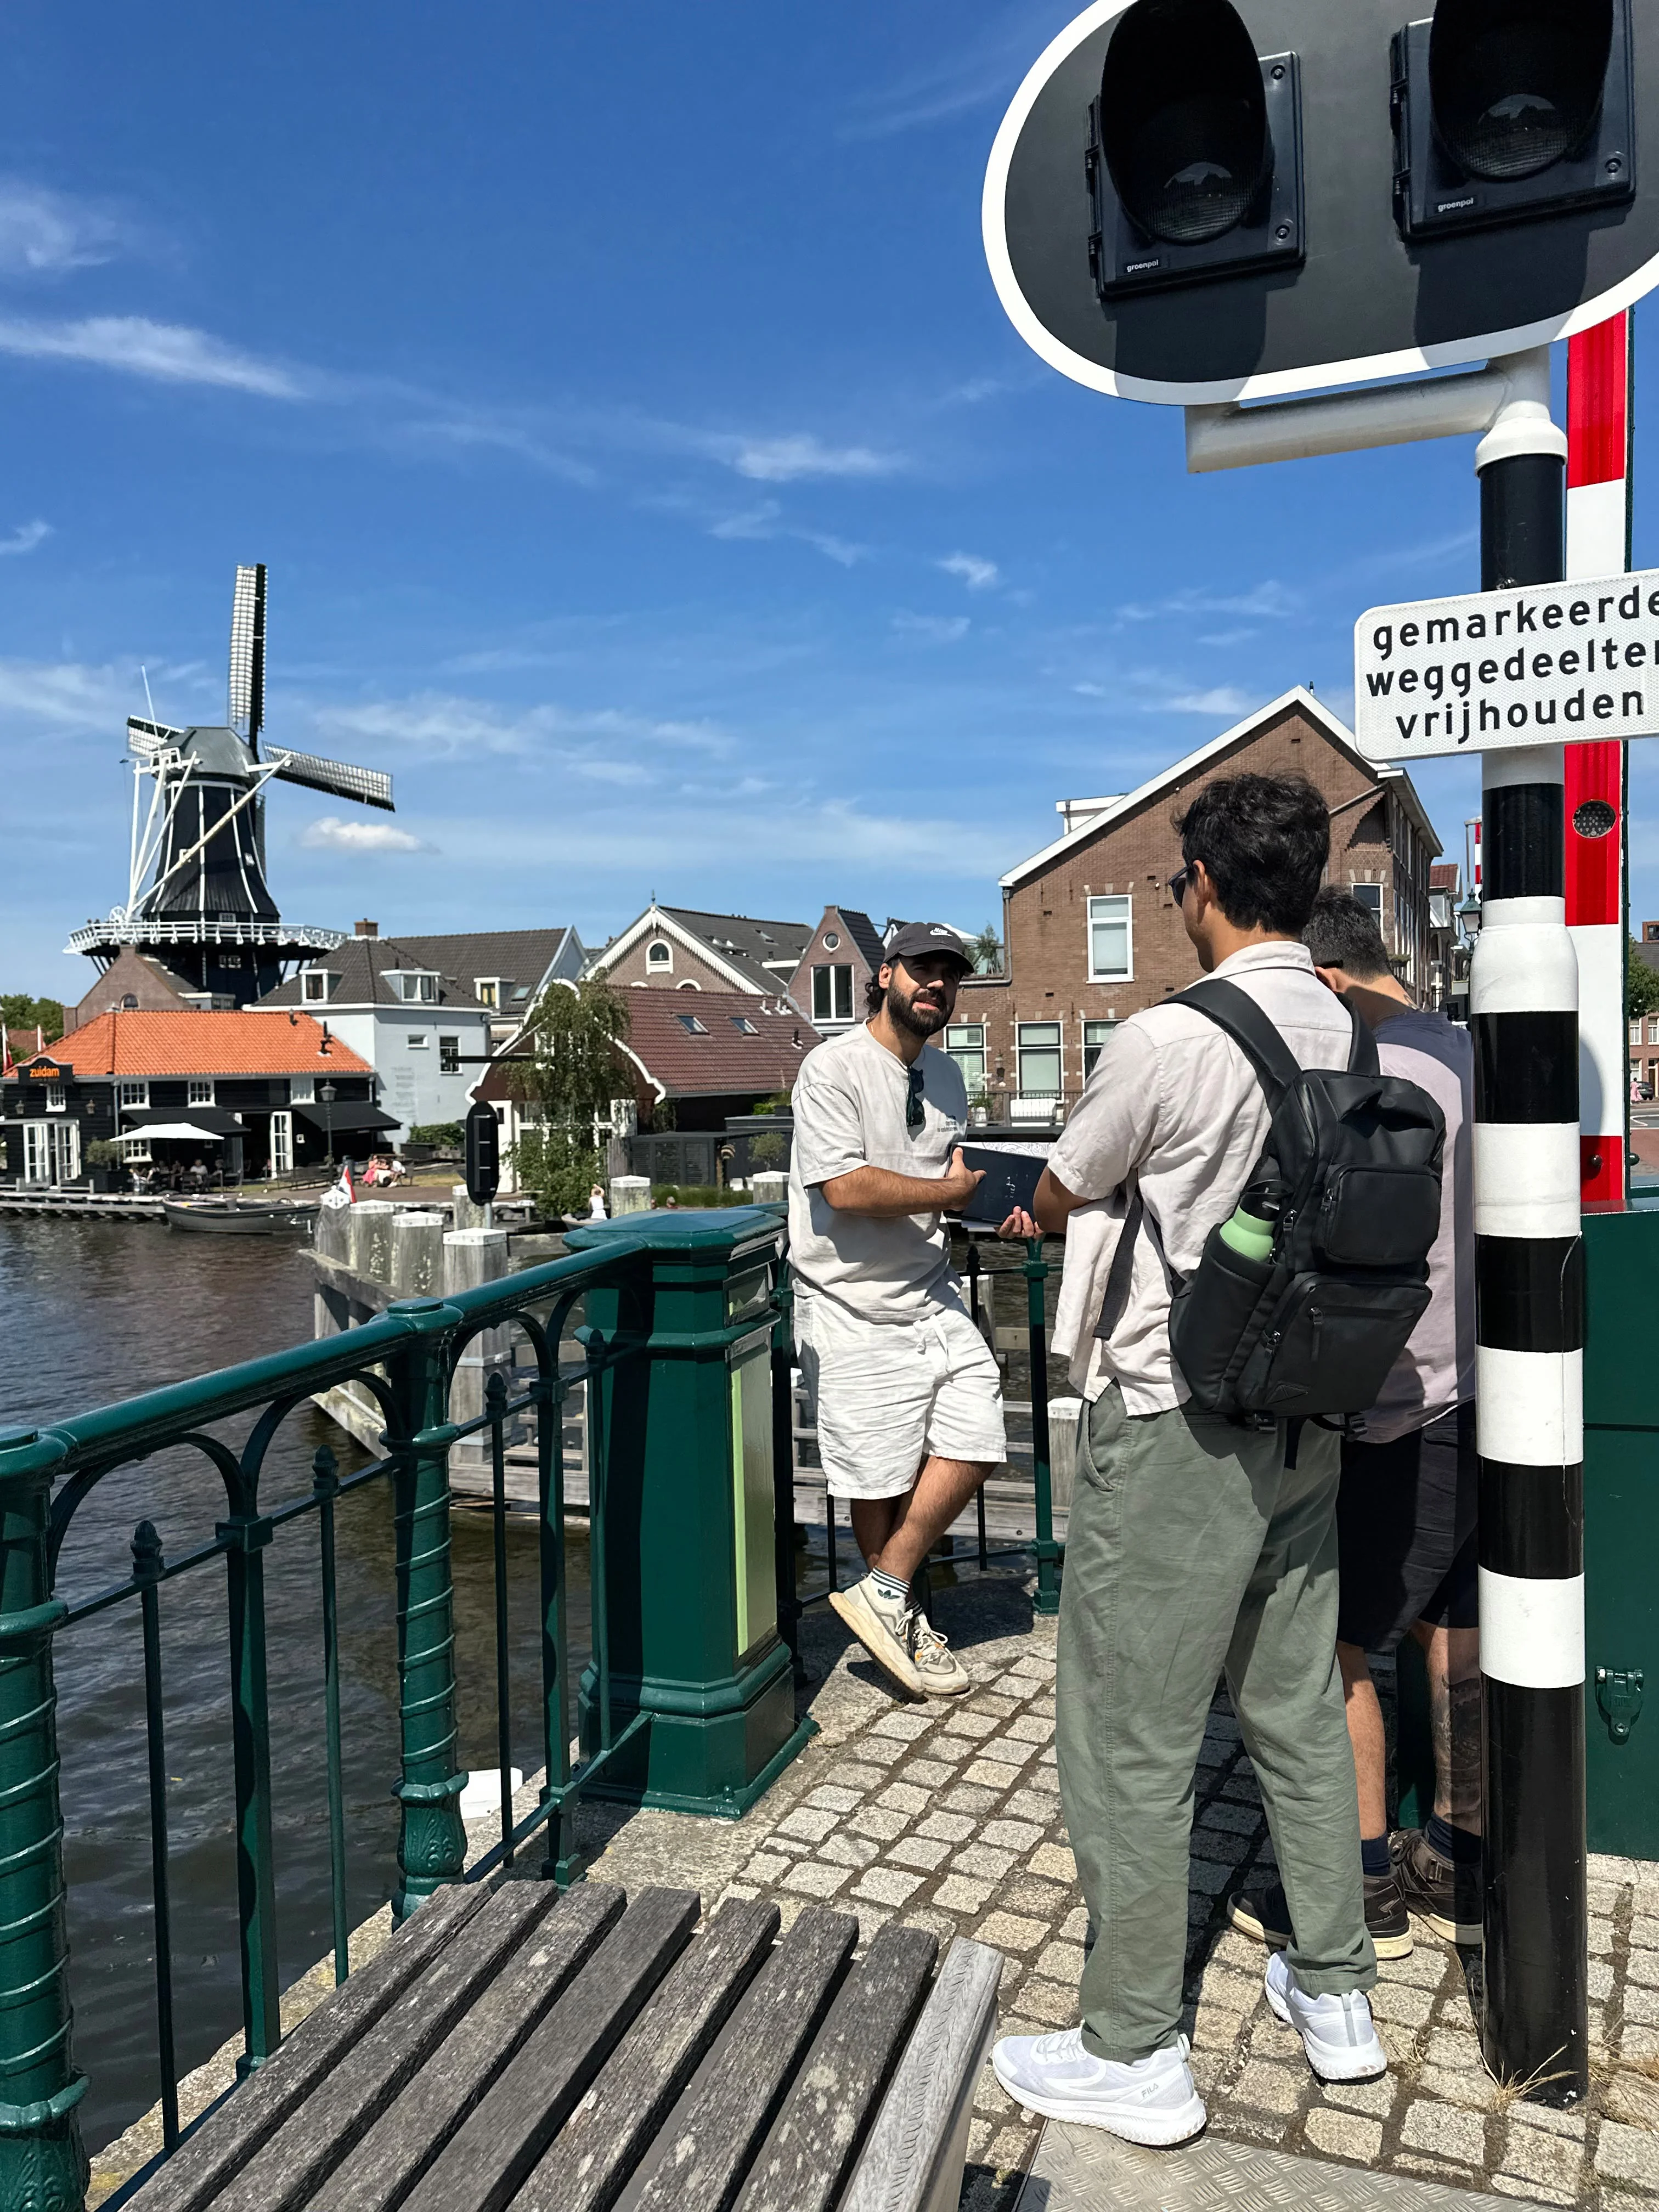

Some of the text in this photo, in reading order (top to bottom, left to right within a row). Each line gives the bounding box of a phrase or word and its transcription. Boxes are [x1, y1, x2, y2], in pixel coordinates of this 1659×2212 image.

[1438, 198, 1474, 212] groenpol
[1127, 259, 1159, 273] groenpol
[1367, 638, 1659, 700] weggedeelte
[1396, 688, 1644, 744] vrijhouden
[29, 1065, 60, 1078] zuidam
[1141, 2083, 1159, 2098] FILA
